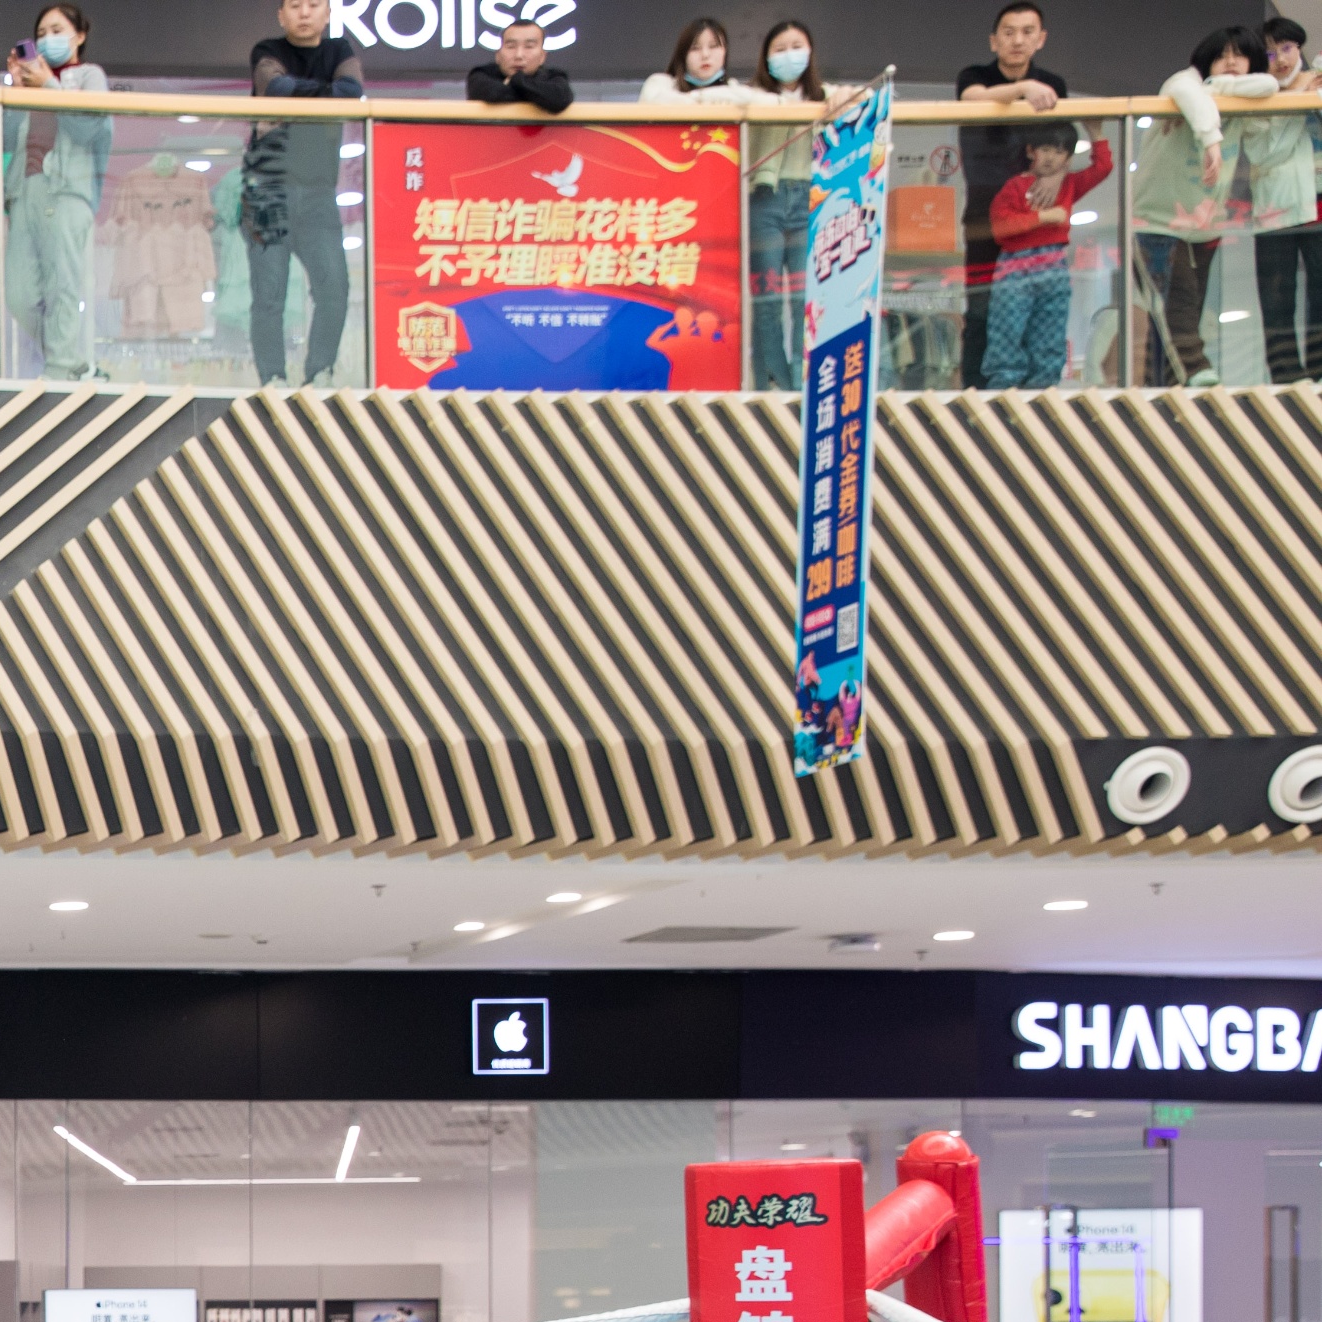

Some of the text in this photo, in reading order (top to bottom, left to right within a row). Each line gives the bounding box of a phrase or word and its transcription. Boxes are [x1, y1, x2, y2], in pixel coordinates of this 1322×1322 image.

[405, 147, 424, 191] 反诈
[413, 197, 698, 242] 短信诈骗花样多
[414, 242, 701, 287] 不予理睬准没错
[706, 1194, 828, 1226] 功夫荣耀
[1075, 1224, 1117, 1235] Phone
